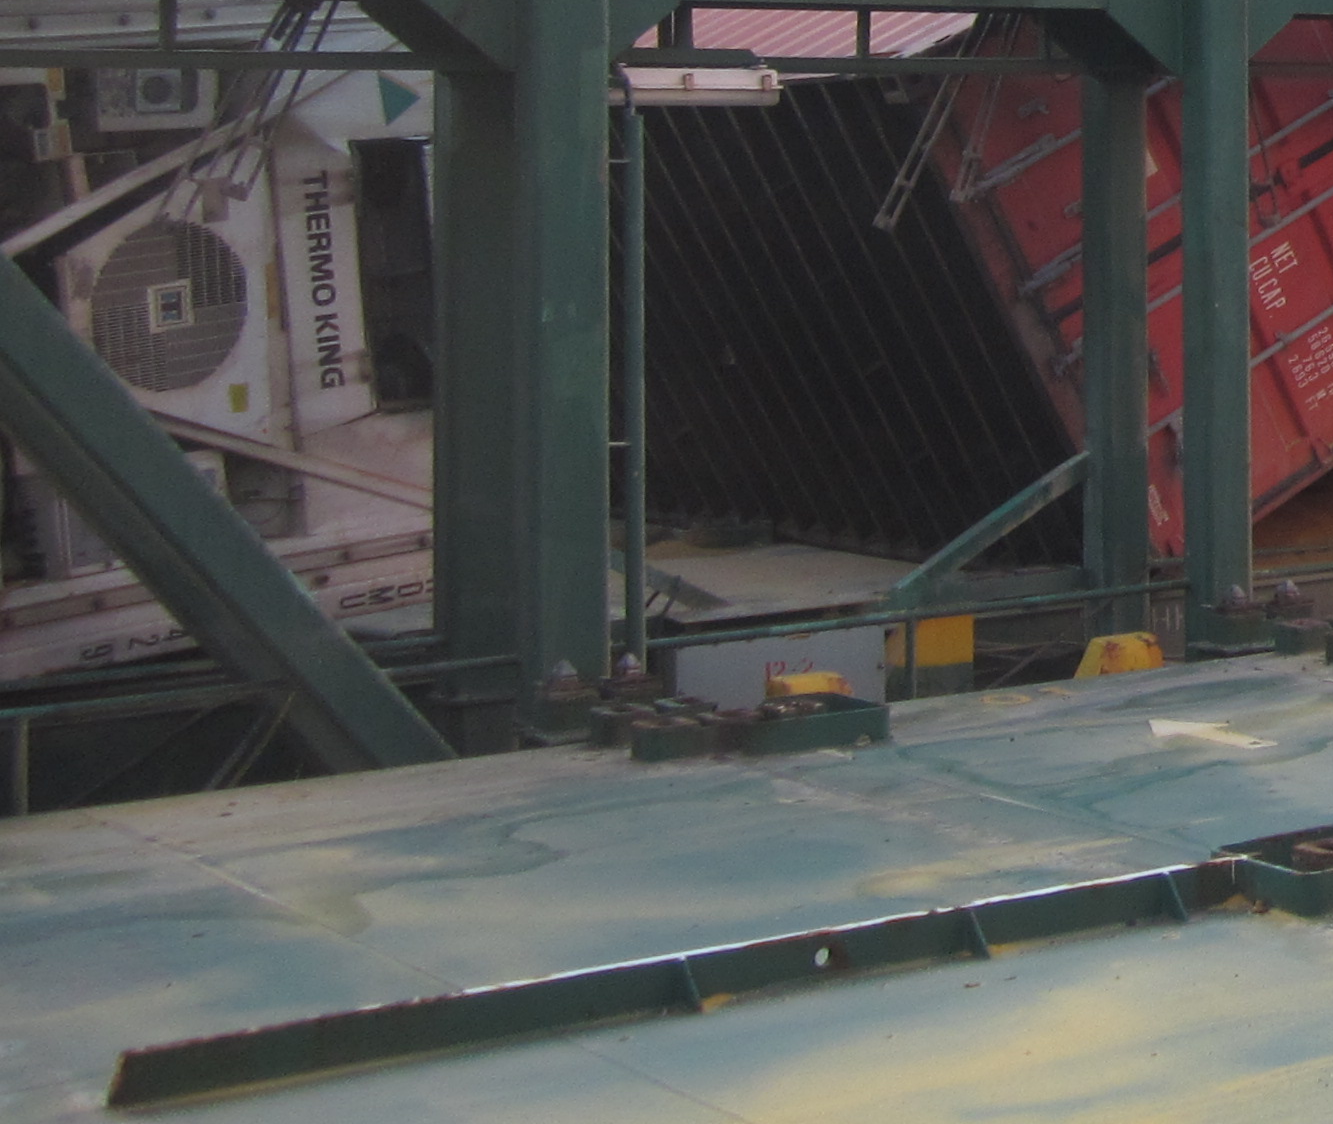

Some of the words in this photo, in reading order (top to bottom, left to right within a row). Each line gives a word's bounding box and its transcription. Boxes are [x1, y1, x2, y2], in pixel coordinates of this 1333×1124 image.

[303, 172, 336, 308] THERMO
[1271, 241, 1296, 274] NET
[316, 313, 345, 390] KING
